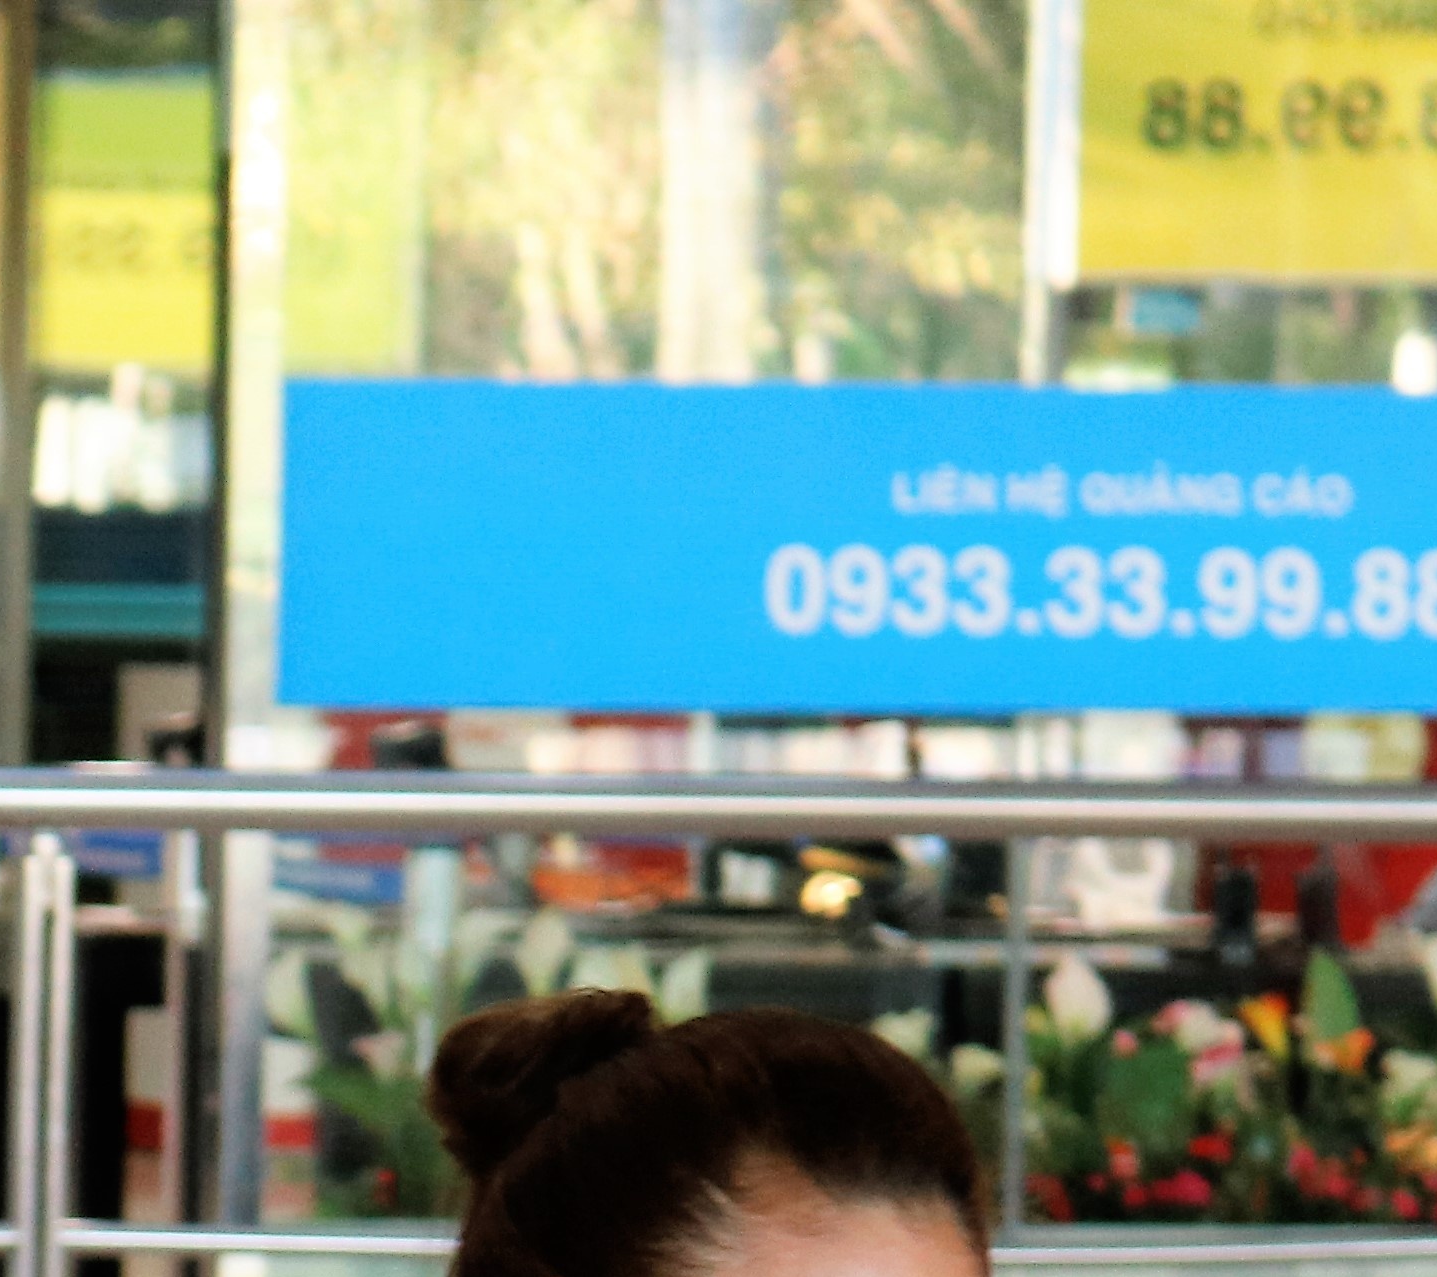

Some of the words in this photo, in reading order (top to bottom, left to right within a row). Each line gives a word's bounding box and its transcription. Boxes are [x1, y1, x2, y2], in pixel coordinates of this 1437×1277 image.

[890, 462, 997, 515] LIÊN
[1004, 462, 1069, 519] HỆ
[1079, 459, 1243, 517] QUẢNG
[1252, 465, 1356, 519] CÁO
